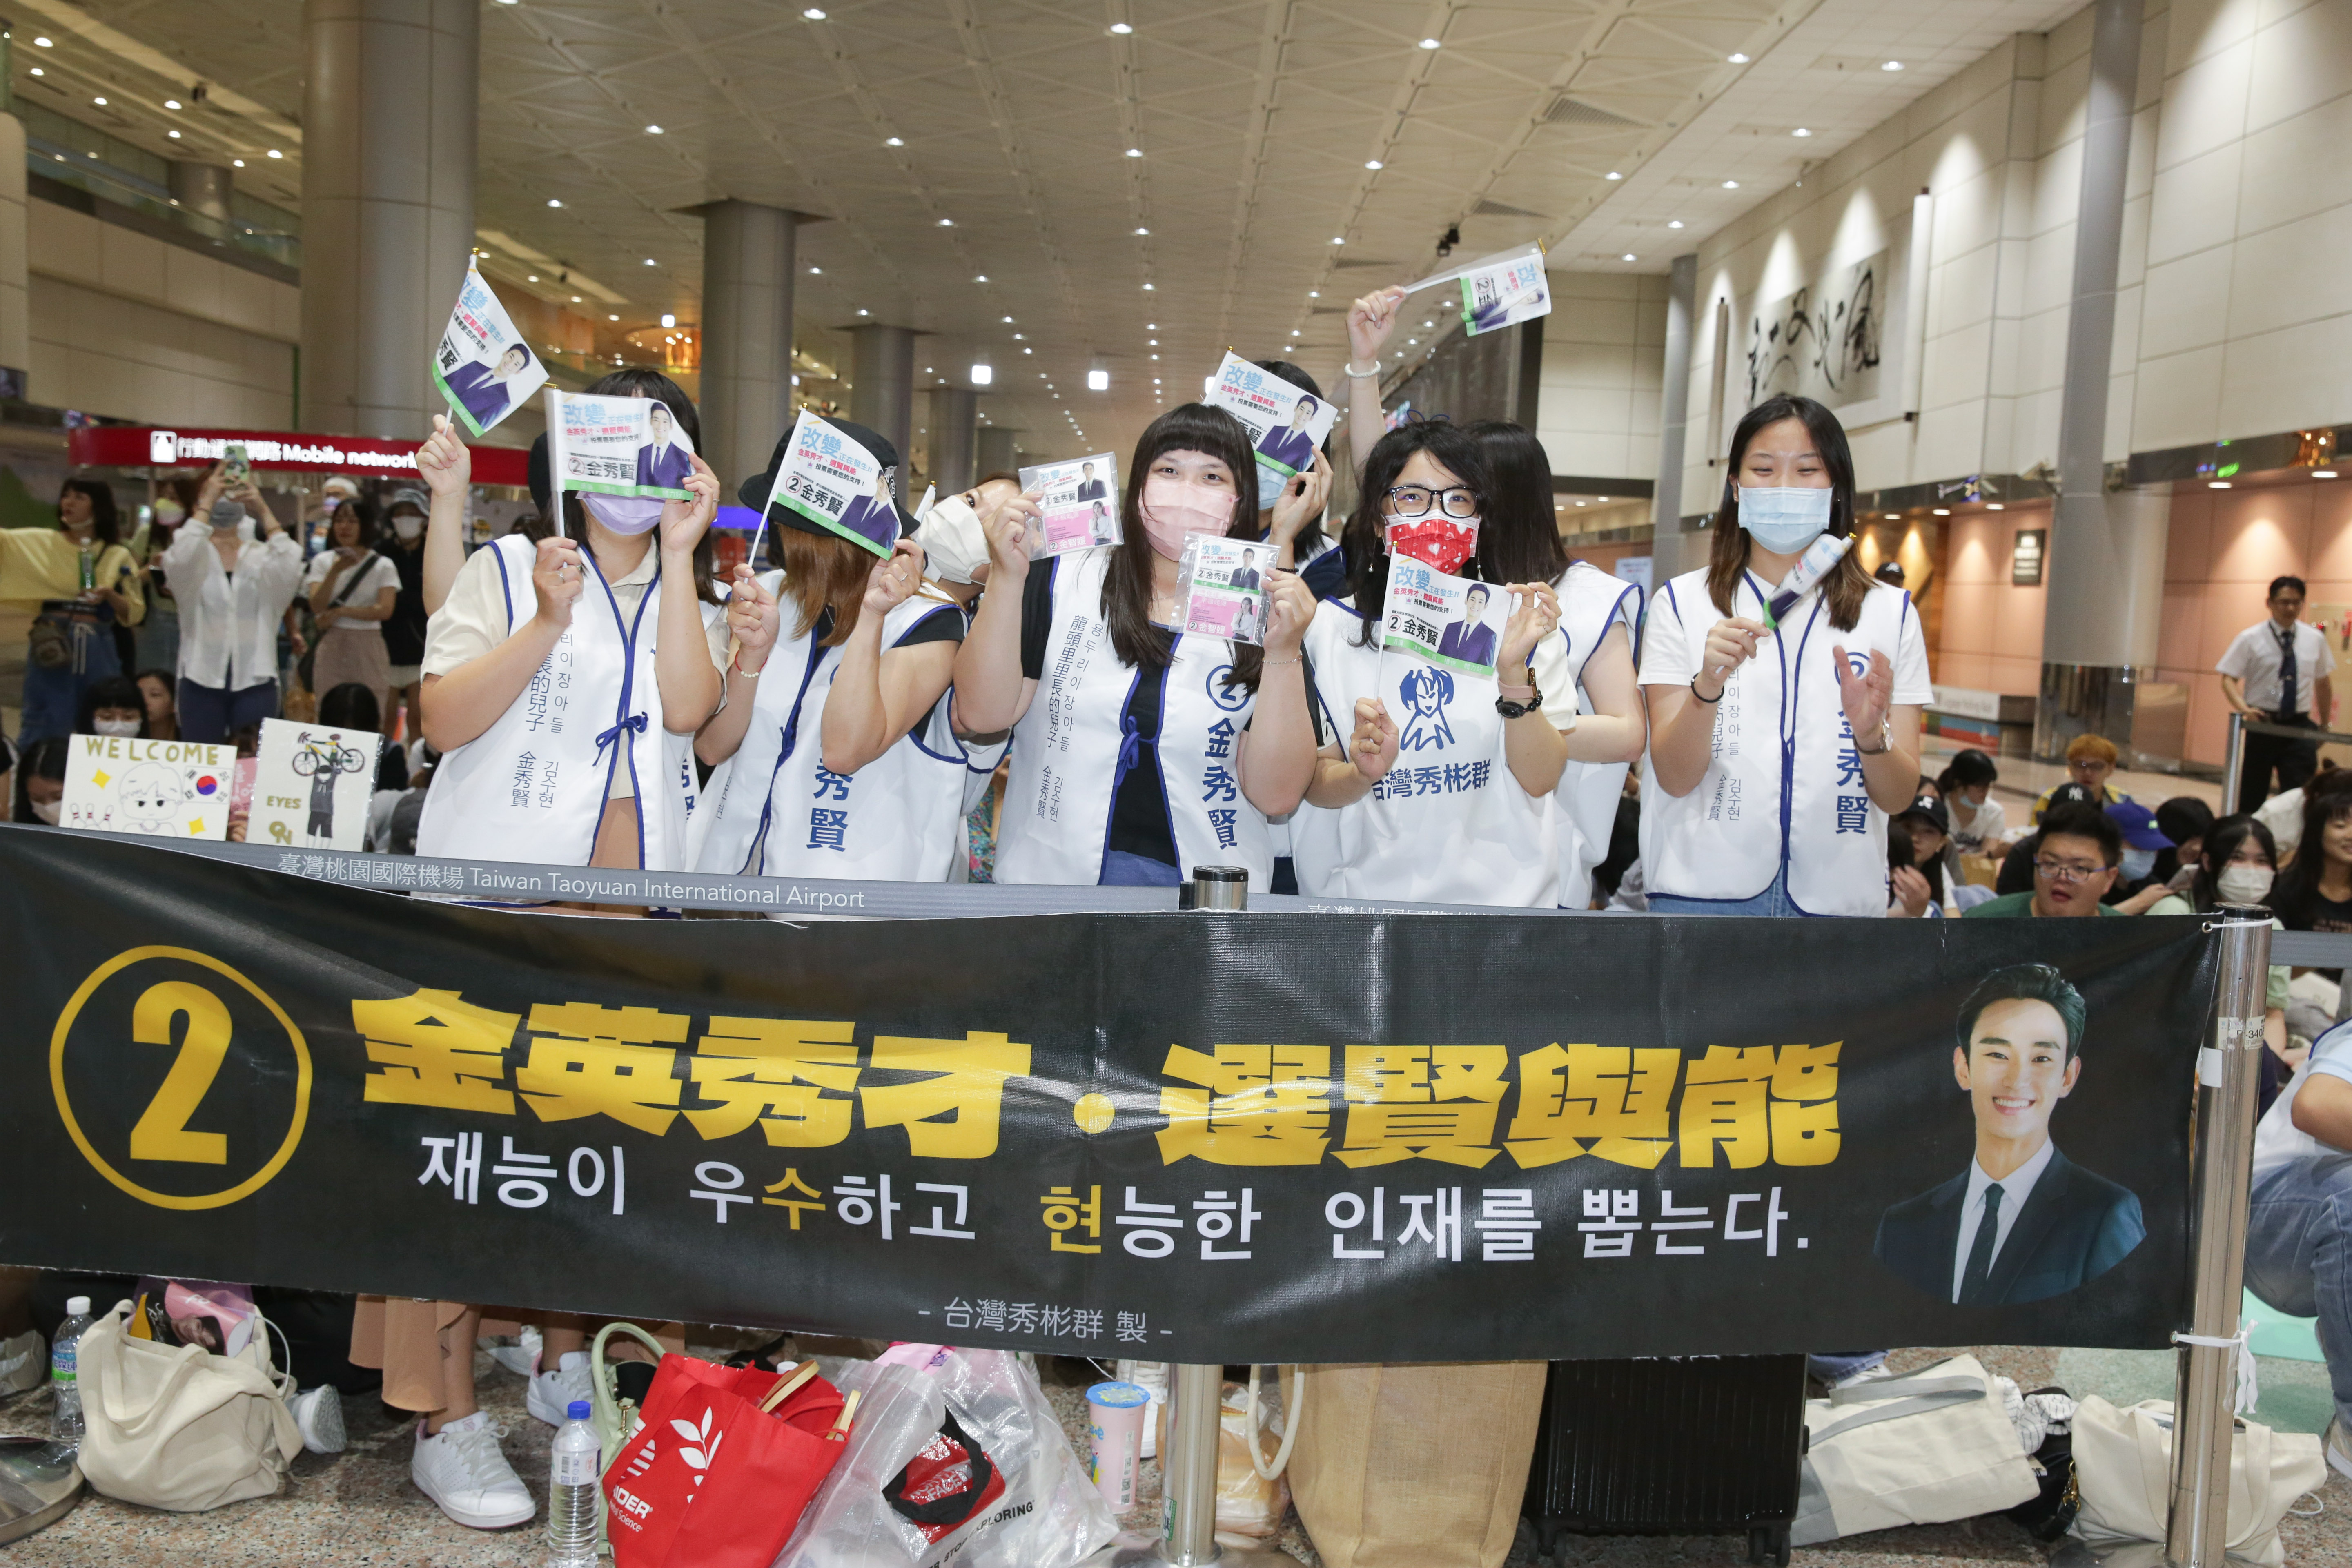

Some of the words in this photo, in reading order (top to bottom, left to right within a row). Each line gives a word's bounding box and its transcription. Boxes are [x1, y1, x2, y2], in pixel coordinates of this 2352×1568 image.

[283, 443, 345, 464] Mobile
[800, 484, 844, 516] 金秀賢
[1402, 619, 1439, 646] 金秀賢
[86, 736, 219, 766] WELCOME
[510, 751, 537, 808] 金秀賢
[1202, 717, 1238, 850] 金秀賢
[267, 795, 301, 809] EYES
[278, 853, 464, 890] 臺灣桃園國際機場
[469, 867, 541, 891] Taiwan
[548, 873, 637, 899] Taoyuan
[645, 878, 780, 904] International
[786, 883, 864, 911] Airport
[417, 1131, 625, 1215] 재능이
[690, 1161, 976, 1240] 우수하고
[1040, 1184, 1262, 1260] 현능한
[1324, 1187, 1542, 1262] 인재를
[1577, 1185, 1809, 1258] 뽑는다.
[944, 1296, 1104, 1340] 台灣秀彬群
